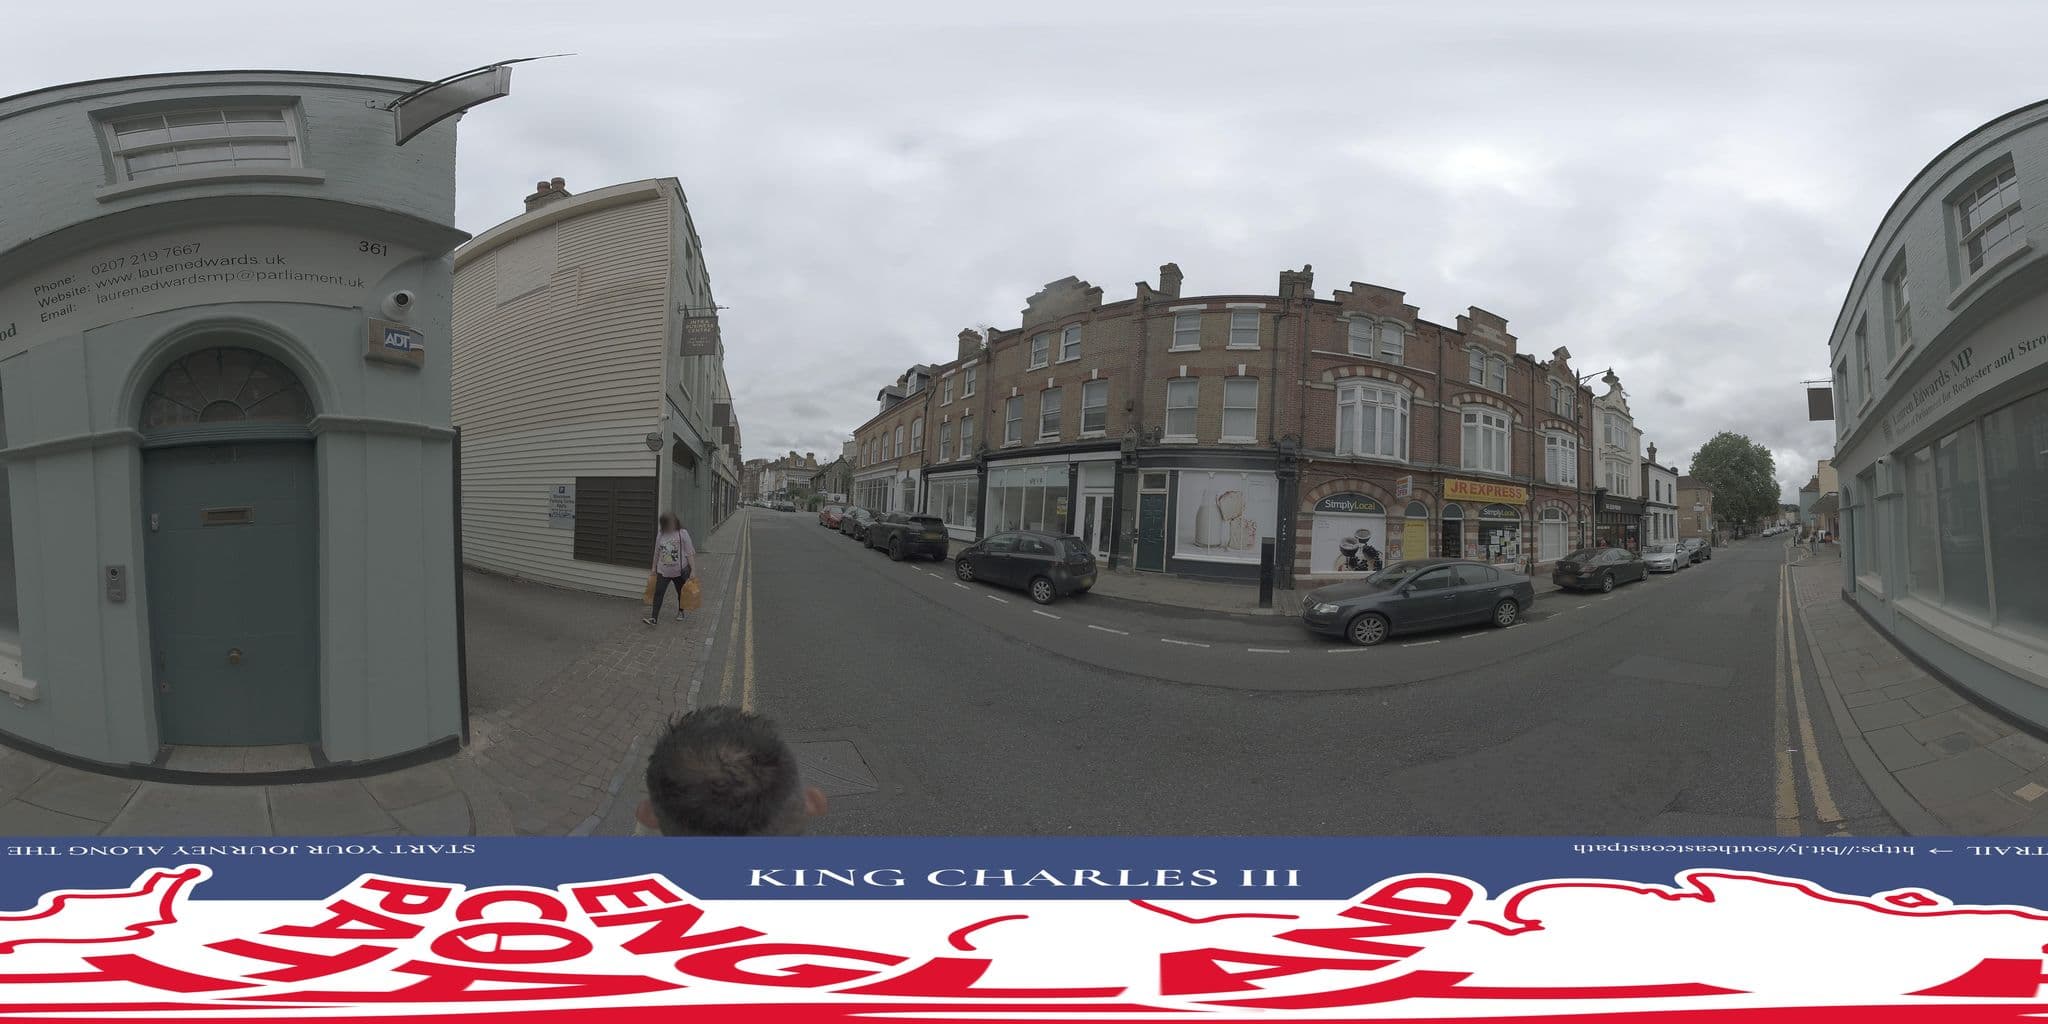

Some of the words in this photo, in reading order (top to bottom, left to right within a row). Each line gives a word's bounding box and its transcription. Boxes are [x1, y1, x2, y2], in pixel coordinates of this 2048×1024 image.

[359, 240, 389, 257] 361
[33, 274, 76, 296] Phone:
[91, 258, 125, 276] 0207
[129, 250, 159, 266] 219
[163, 242, 201, 258] 7667
[38, 284, 91, 308] Website:
[40, 303, 77, 323] Email:
[385, 332, 410, 349] ADT
[1912, 370, 1950, 408] Edwards
[1950, 347, 1974, 377] MP
[1952, 363, 1992, 396] Rochester
[1993, 348, 2015, 369] and
[1450, 480, 1468, 494] JR
[1470, 483, 1522, 499] EXPRESS
